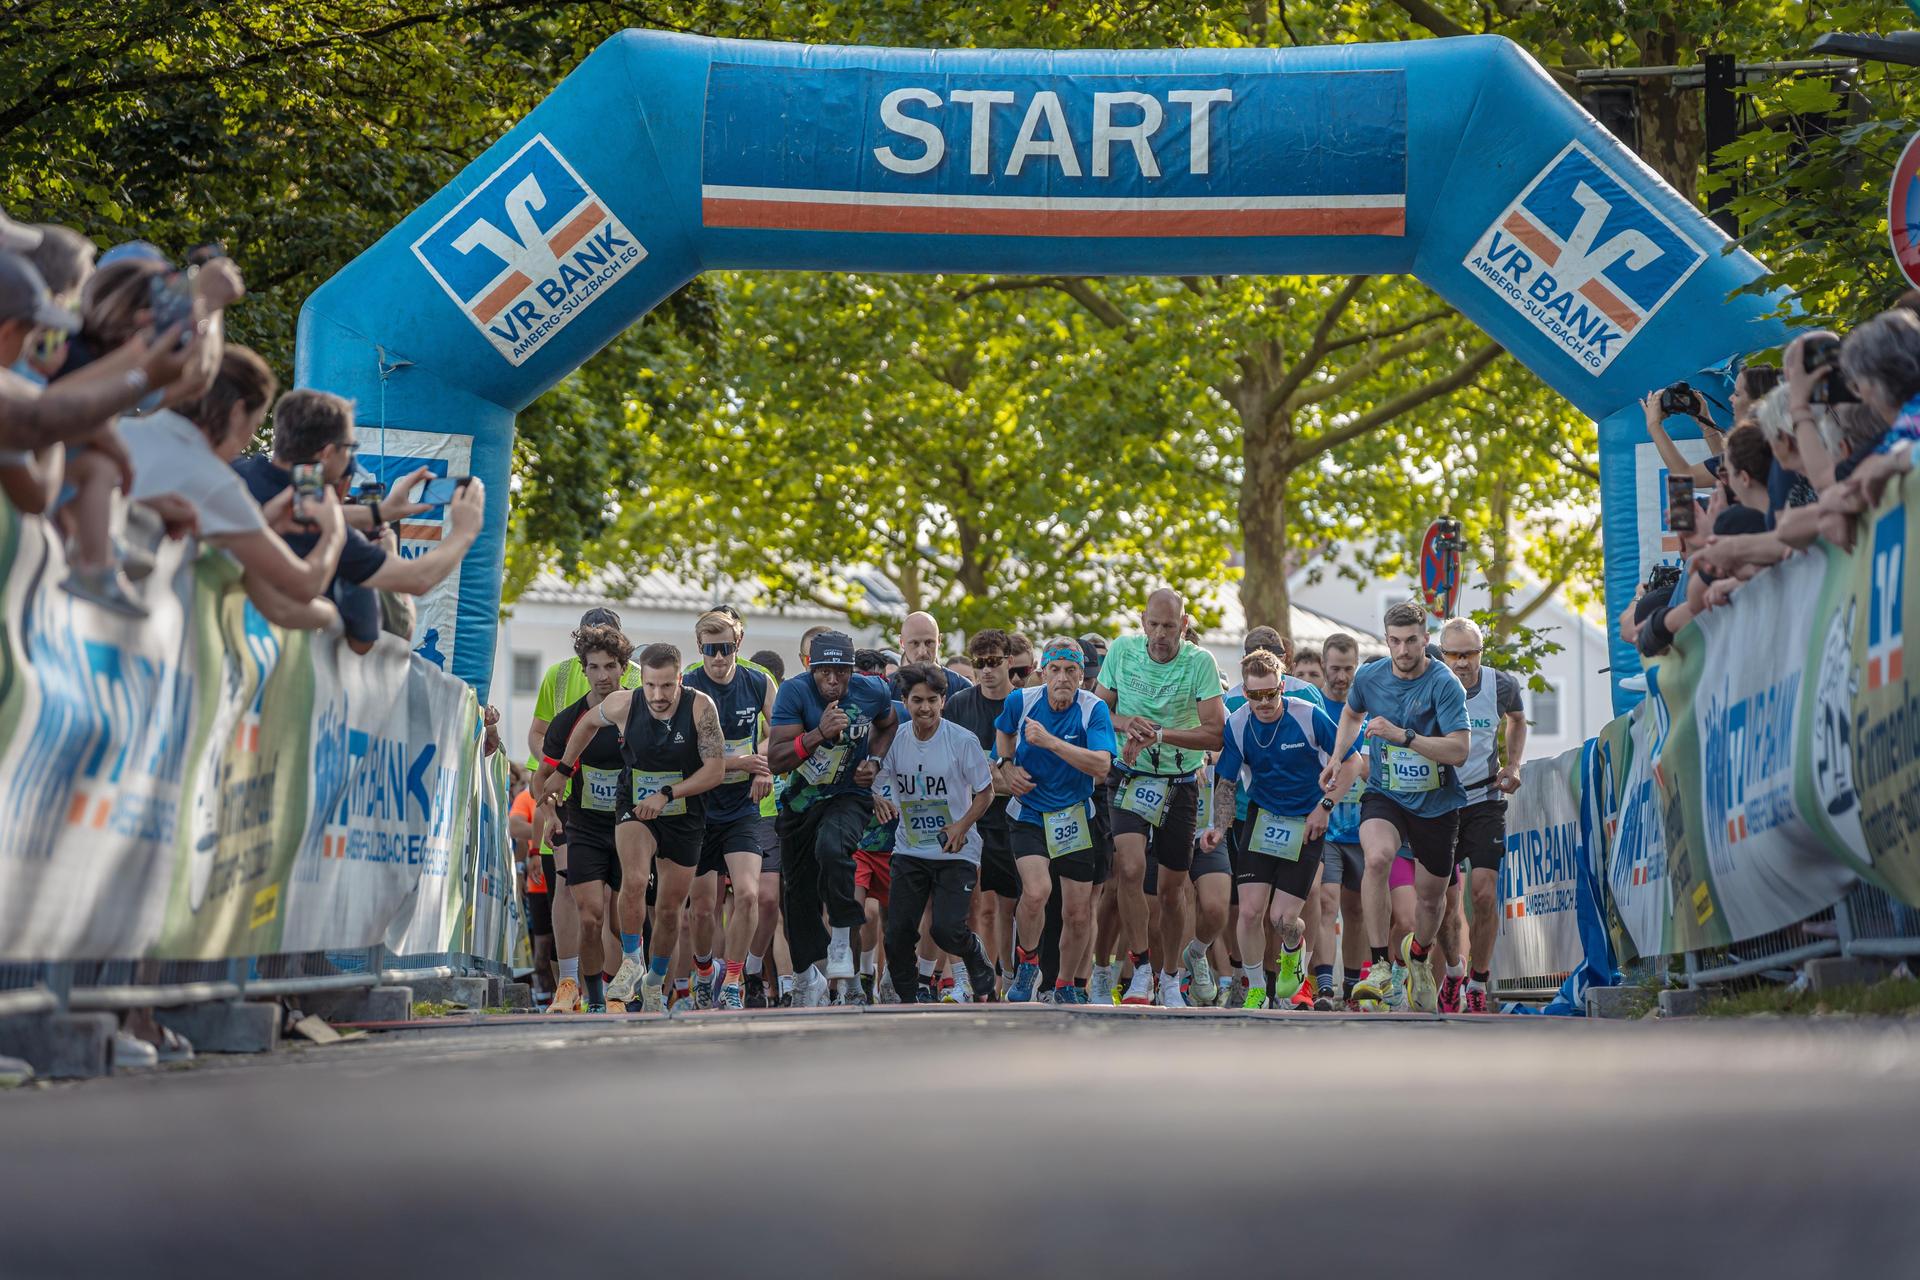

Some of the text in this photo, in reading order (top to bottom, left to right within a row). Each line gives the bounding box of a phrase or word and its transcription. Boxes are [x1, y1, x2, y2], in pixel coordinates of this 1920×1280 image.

[873, 87, 1233, 177] START
[489, 222, 630, 344] VR BANK
[512, 246, 639, 359] AMBERG-SULZBACH EG
[1471, 256, 1602, 368] AMBERG-SULZBACH EG
[1485, 231, 1622, 358] VR BANK
[1135, 787, 1163, 806] 667
[1393, 763, 1430, 777] 1450
[910, 815, 946, 830] 2196
[1054, 821, 1079, 841] 336
[1264, 826, 1291, 842] 371
[1521, 829, 1544, 887] VR
